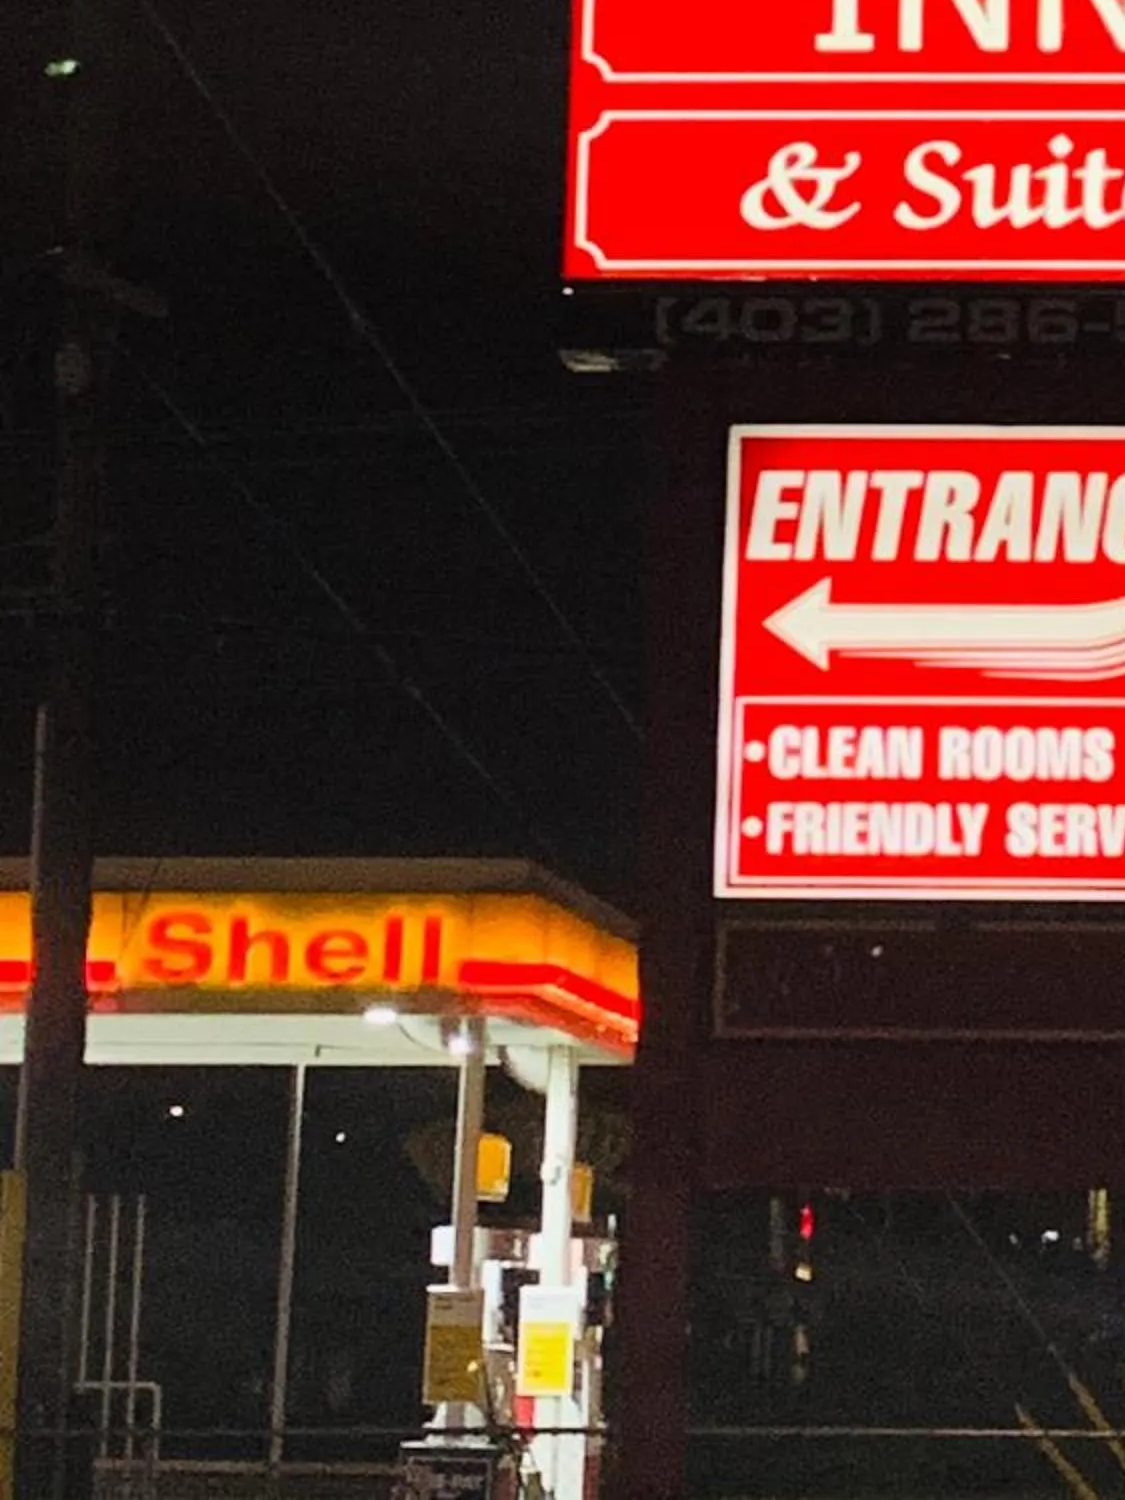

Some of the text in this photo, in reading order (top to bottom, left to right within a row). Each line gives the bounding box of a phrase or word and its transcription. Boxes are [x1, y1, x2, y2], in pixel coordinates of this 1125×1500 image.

[740, 142, 861, 230] &
[656, 296, 883, 346] (403)
[938, 726, 1115, 782] ROOMS
[143, 909, 443, 984] Shell
